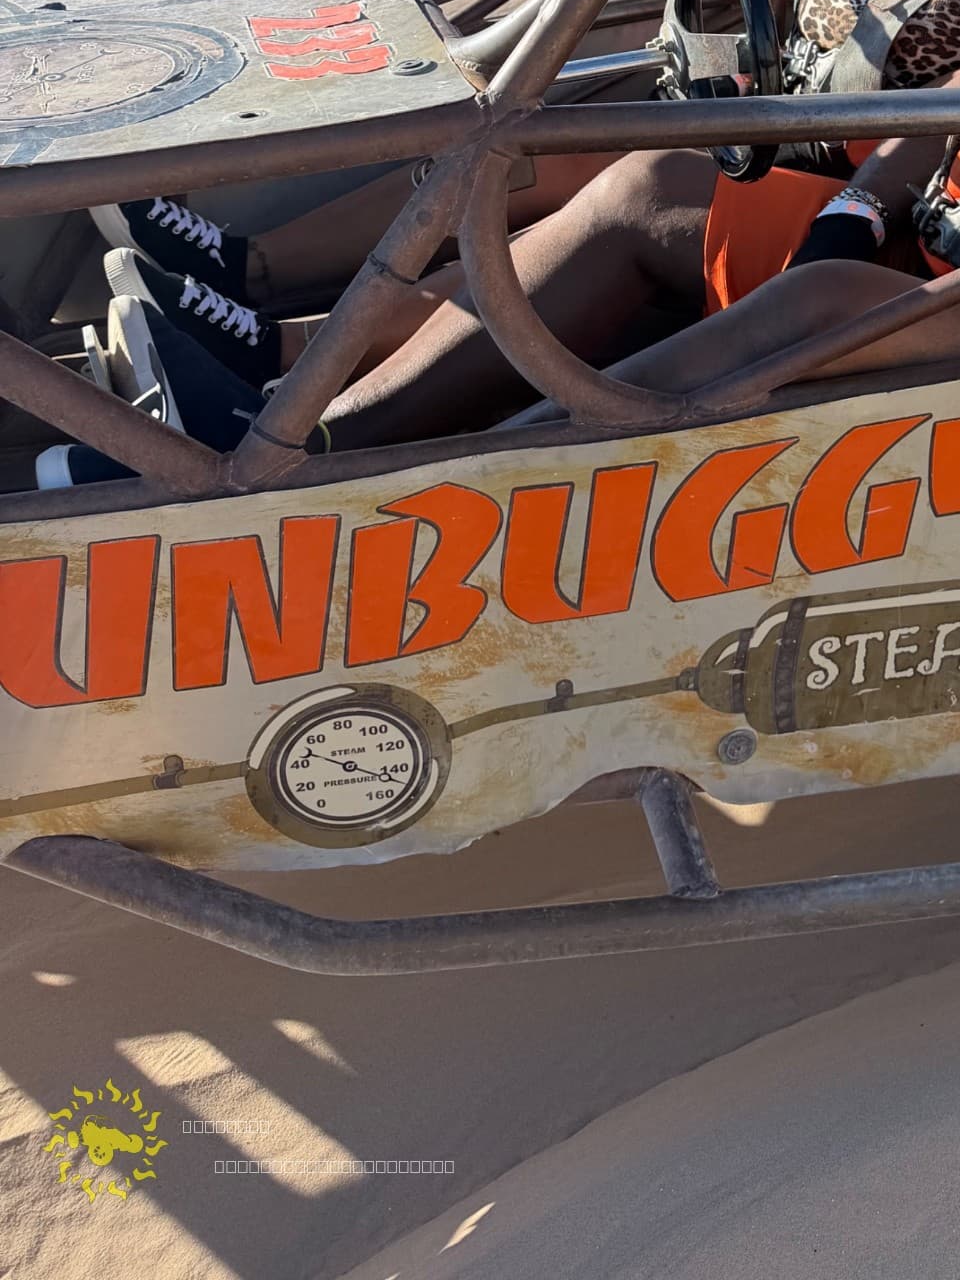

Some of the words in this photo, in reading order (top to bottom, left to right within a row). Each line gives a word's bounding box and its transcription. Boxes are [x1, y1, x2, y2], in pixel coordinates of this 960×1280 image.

[332, 719, 353, 731] 80
[359, 724, 388, 737] 100
[306, 734, 326, 745] 60
[330, 746, 366, 757] STEAM
[376, 739, 405, 753] 120
[290, 759, 310, 769] 40
[380, 762, 409, 774] 140
[295, 781, 315, 793] 20
[323, 775, 378, 788] PRESSURE
[366, 789, 395, 801] 160
[316, 799, 326, 809] 0
